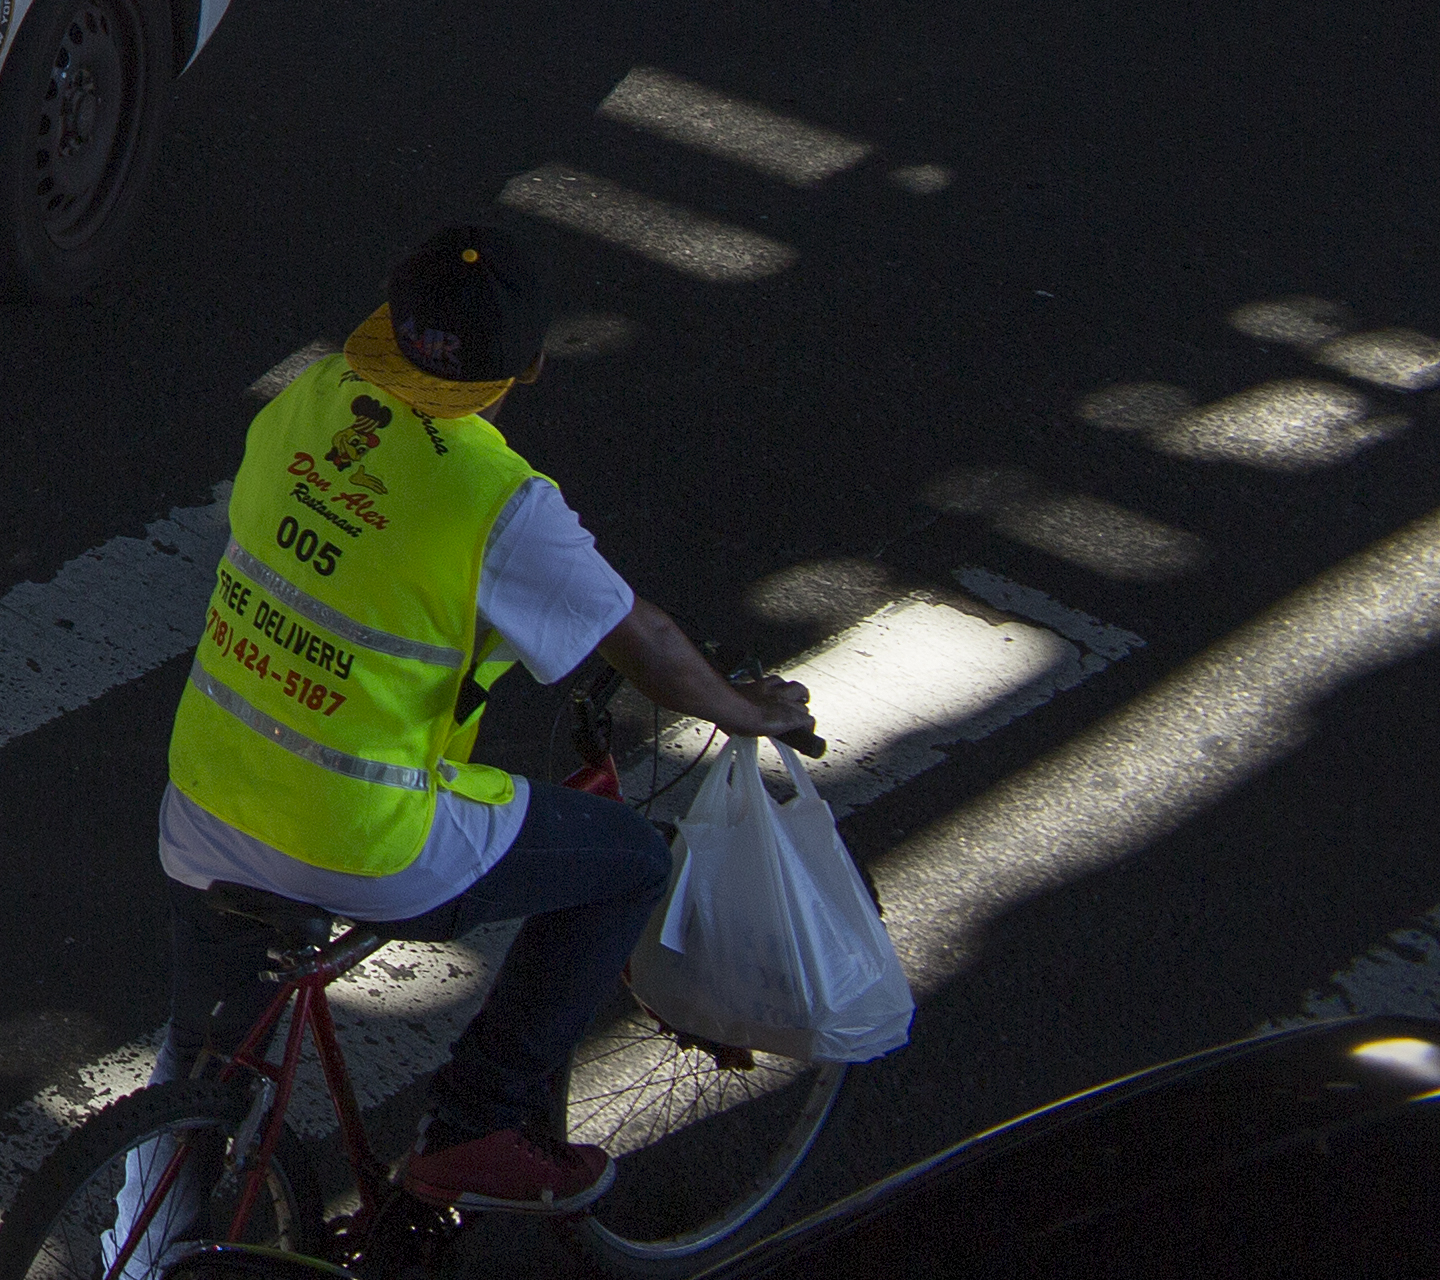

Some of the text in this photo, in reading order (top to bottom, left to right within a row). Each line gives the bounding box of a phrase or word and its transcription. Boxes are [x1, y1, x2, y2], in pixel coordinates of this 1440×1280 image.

[287, 451, 389, 531] Don Alex
[289, 482, 364, 539] Restaurant
[275, 514, 344, 578] 005
[218, 568, 356, 681] FREE DELIVERY
